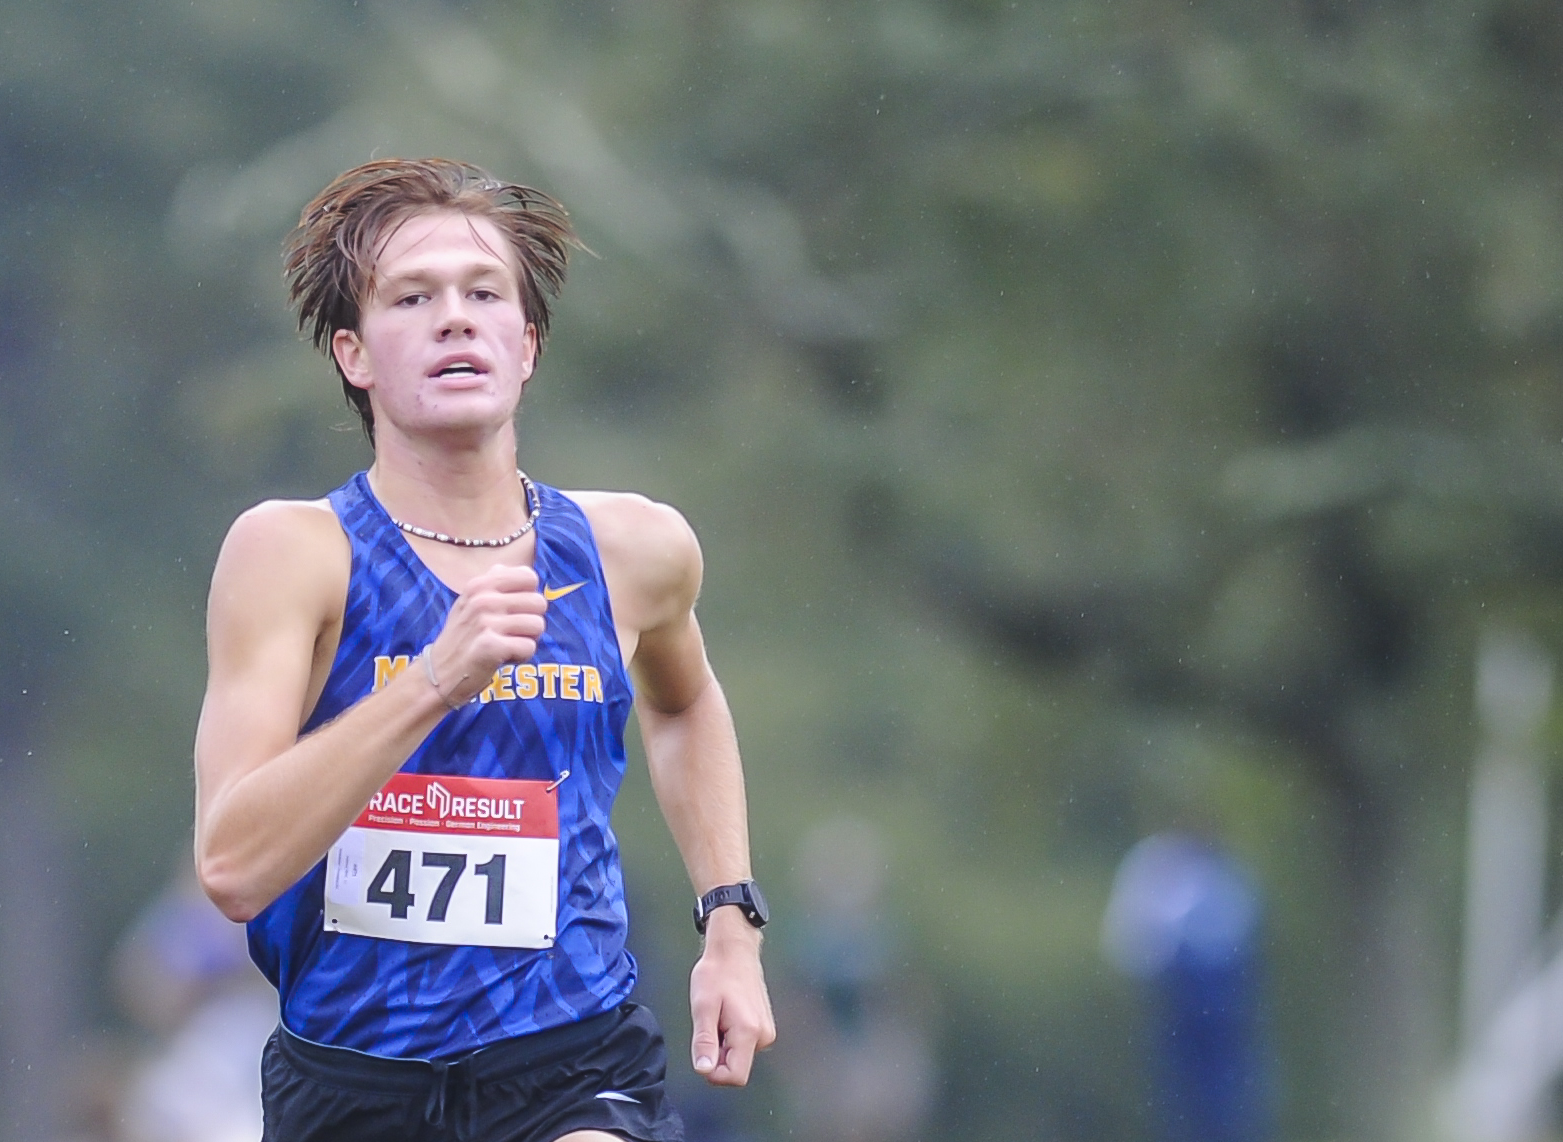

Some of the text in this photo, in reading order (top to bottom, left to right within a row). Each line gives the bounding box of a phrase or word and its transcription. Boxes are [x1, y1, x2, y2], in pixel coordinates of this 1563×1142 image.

[372, 655, 604, 704] MESTER
[369, 792, 525, 820] RACE RESULT
[366, 849, 507, 925] 471
